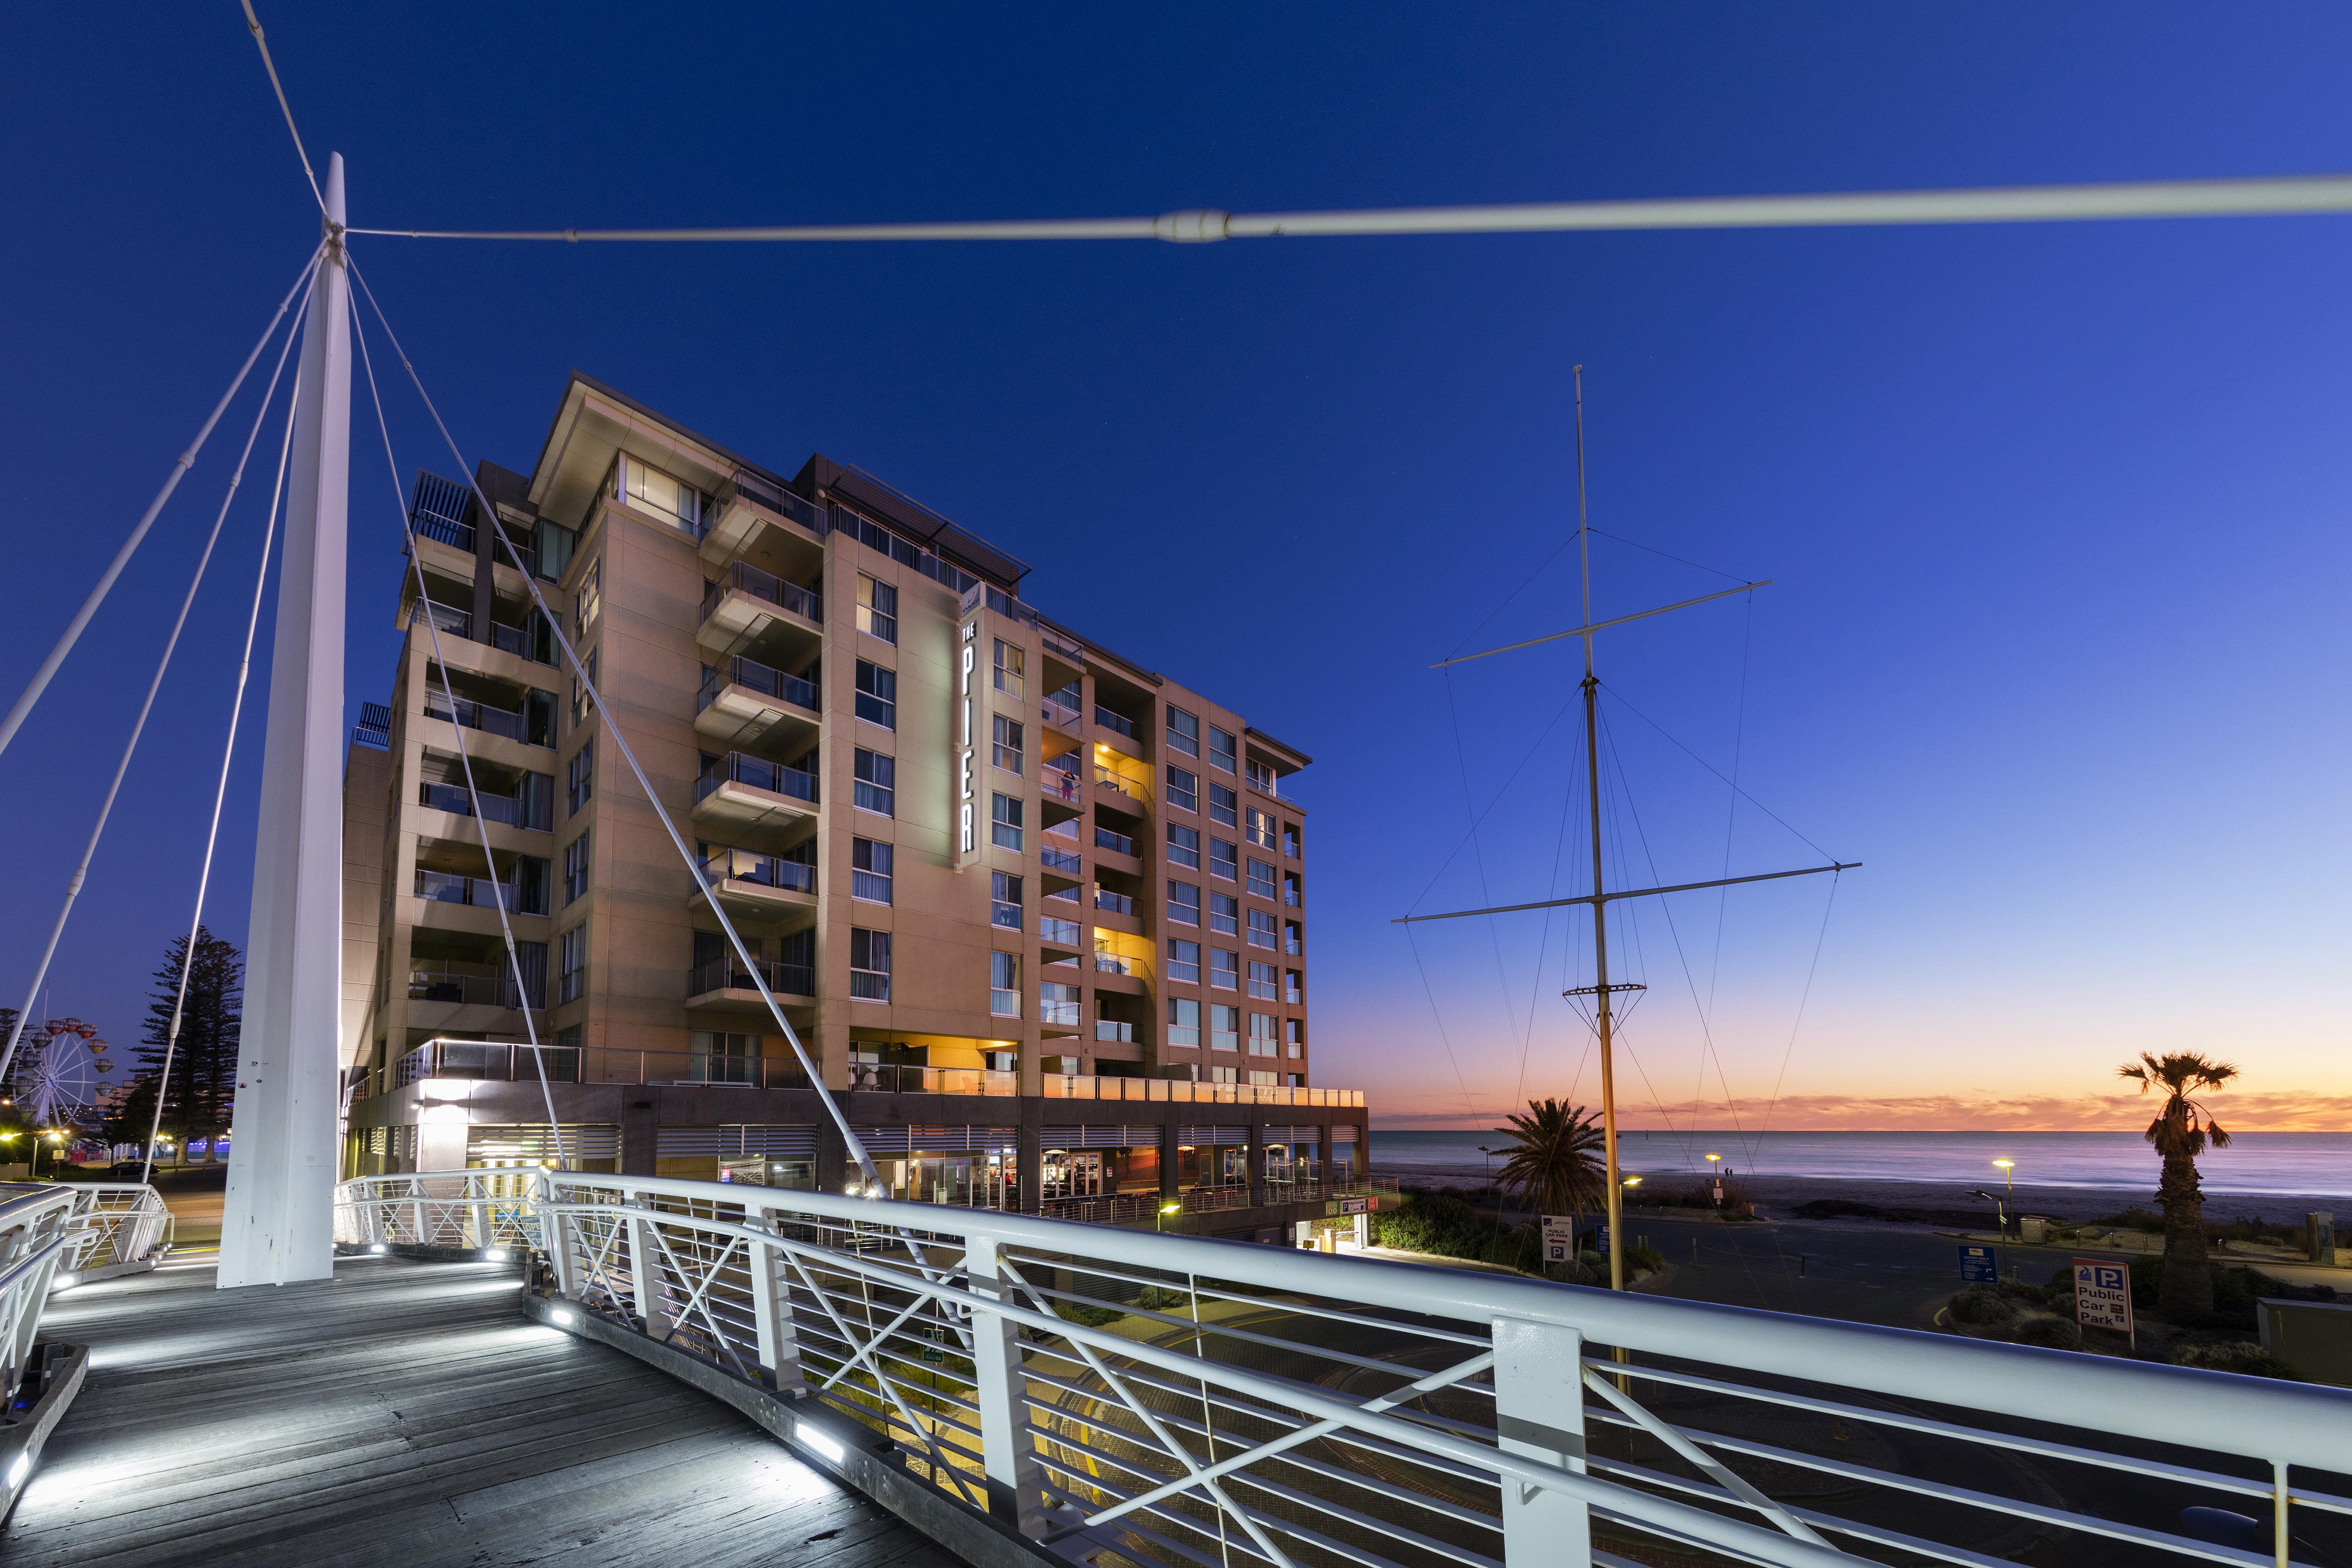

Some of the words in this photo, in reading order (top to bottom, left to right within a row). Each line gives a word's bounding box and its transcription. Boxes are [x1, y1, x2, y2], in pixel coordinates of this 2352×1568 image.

[962, 597, 980, 613] OAKS
[962, 622, 975, 643] THE
[962, 645, 974, 853] PIER
[525, 1223, 541, 1231] OPE
[1553, 1247, 1561, 1257] P
[2101, 1270, 2118, 1286] P
[2079, 1287, 2124, 1301] Public
[2080, 1300, 2105, 1311] Car
[2081, 1312, 2114, 1326] Park
